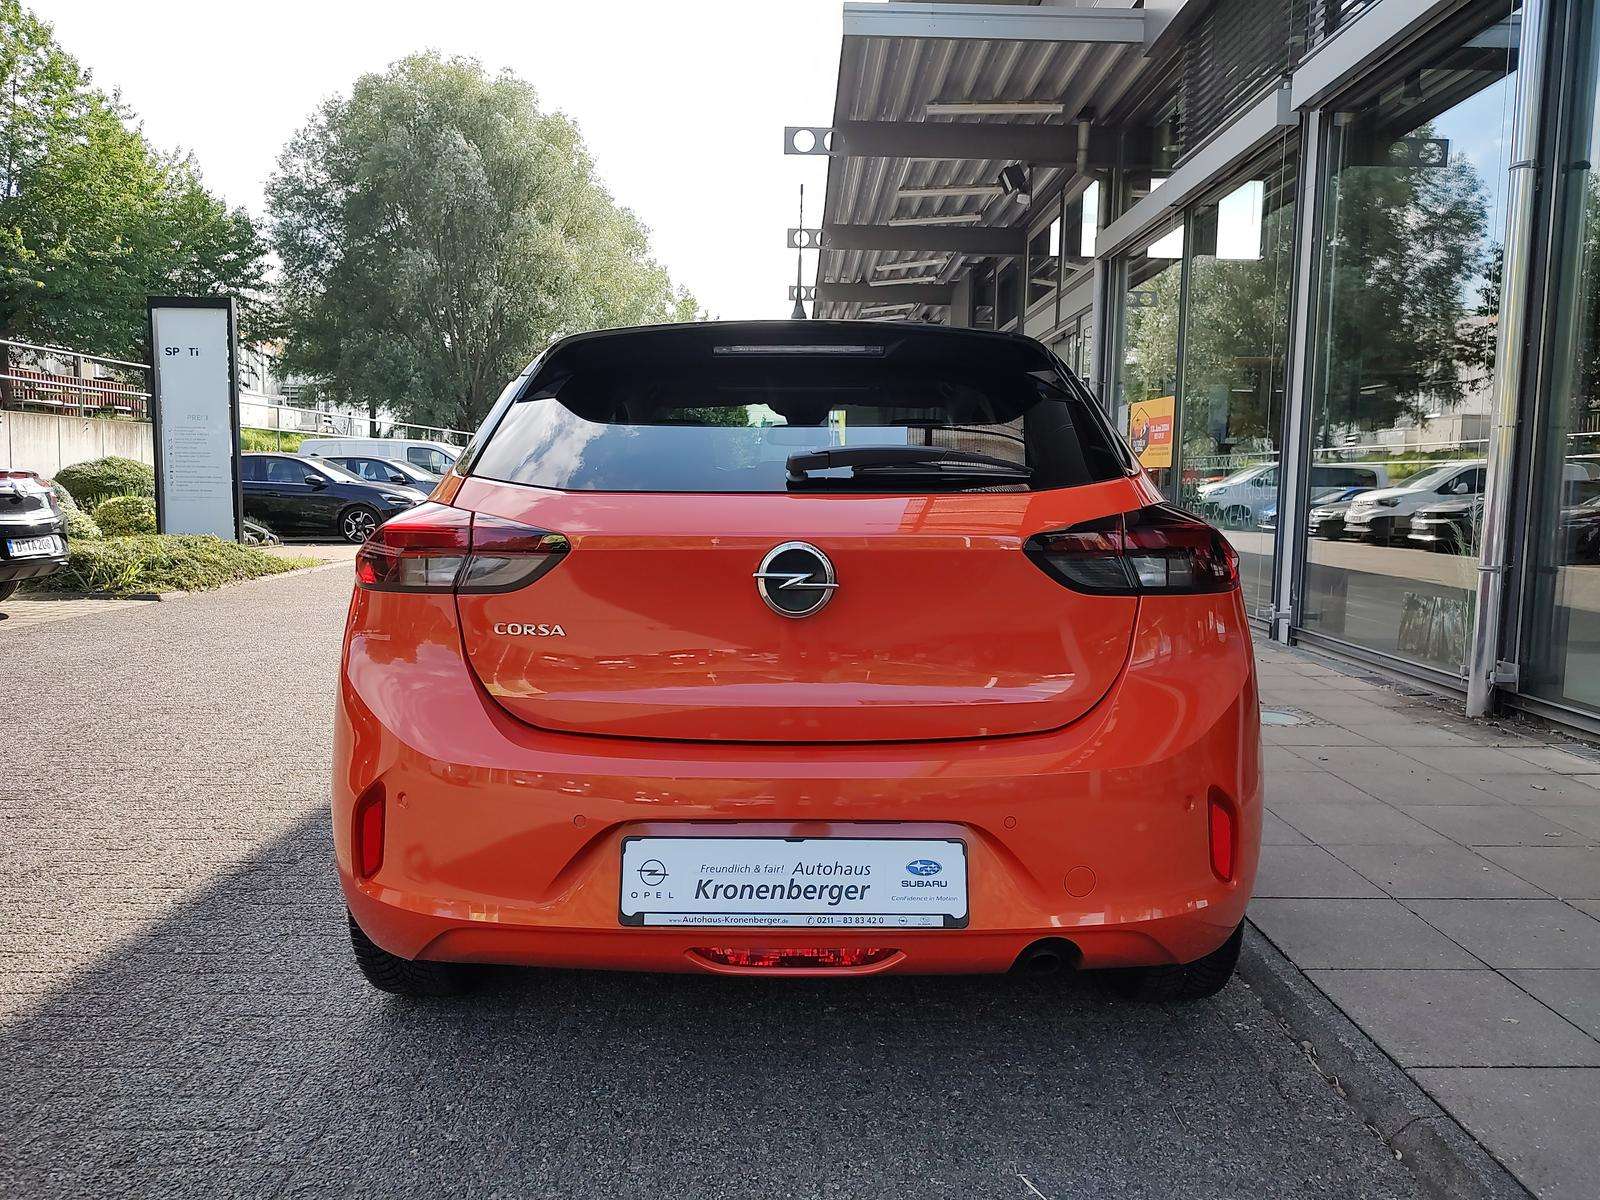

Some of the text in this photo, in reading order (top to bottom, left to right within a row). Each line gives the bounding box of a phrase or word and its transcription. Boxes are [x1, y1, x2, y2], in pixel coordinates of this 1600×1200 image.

[165, 347, 199, 357] SP Ti
[493, 622, 567, 636] CORSA
[700, 860, 872, 875] Freundlich & fair! Autohaus
[901, 880, 948, 888] SUBARU
[630, 891, 674, 899] OPEL
[694, 878, 871, 906] Kronenberger
[668, 915, 789, 925] www.Autohaus-Kronenberger.de
[816, 916, 834, 924] 0211
[843, 916, 853, 924] 83
[855, 916, 865, 924] 83
[866, 916, 877, 924] 42
